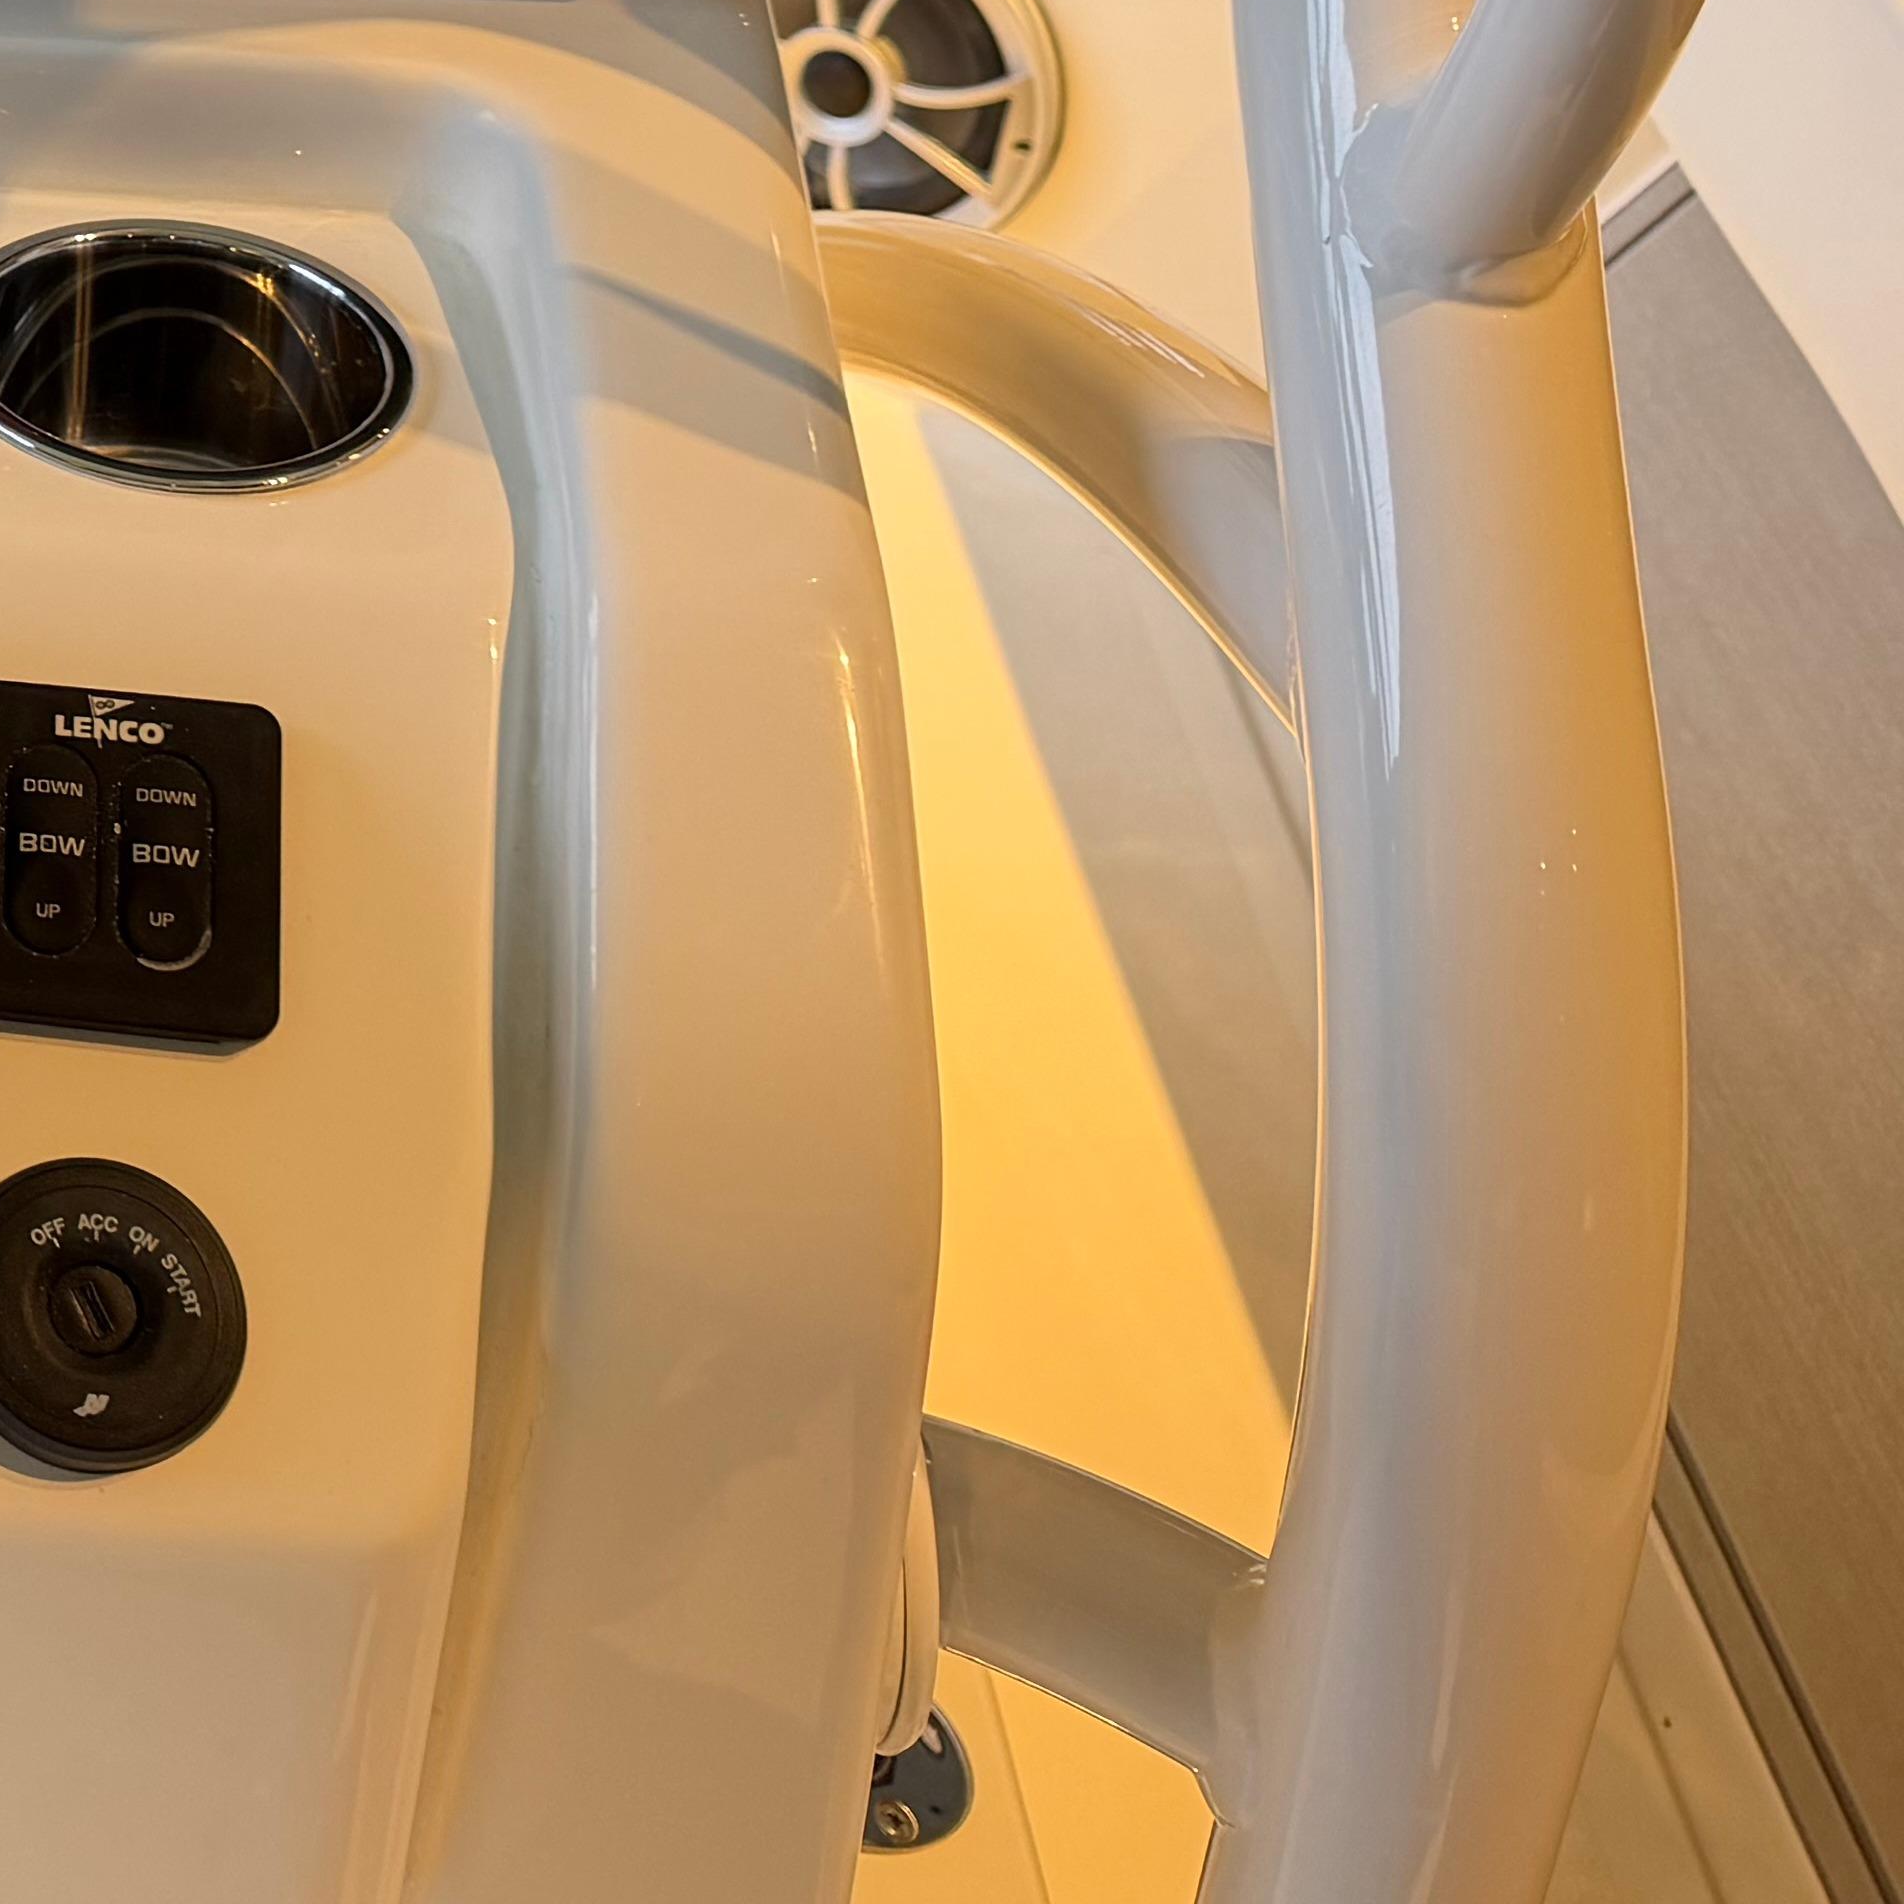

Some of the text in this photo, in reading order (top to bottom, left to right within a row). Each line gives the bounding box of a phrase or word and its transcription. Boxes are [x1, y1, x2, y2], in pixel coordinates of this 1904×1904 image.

[54, 714, 165, 746] LENCO
[23, 778, 84, 798] DOWN
[136, 787, 197, 807] DOWN
[19, 832, 86, 857] BOW
[132, 843, 200, 868] BOW
[36, 902, 61, 919] UP
[149, 911, 175, 928] UP
[30, 1213, 202, 1318] OFF ACC ON START
